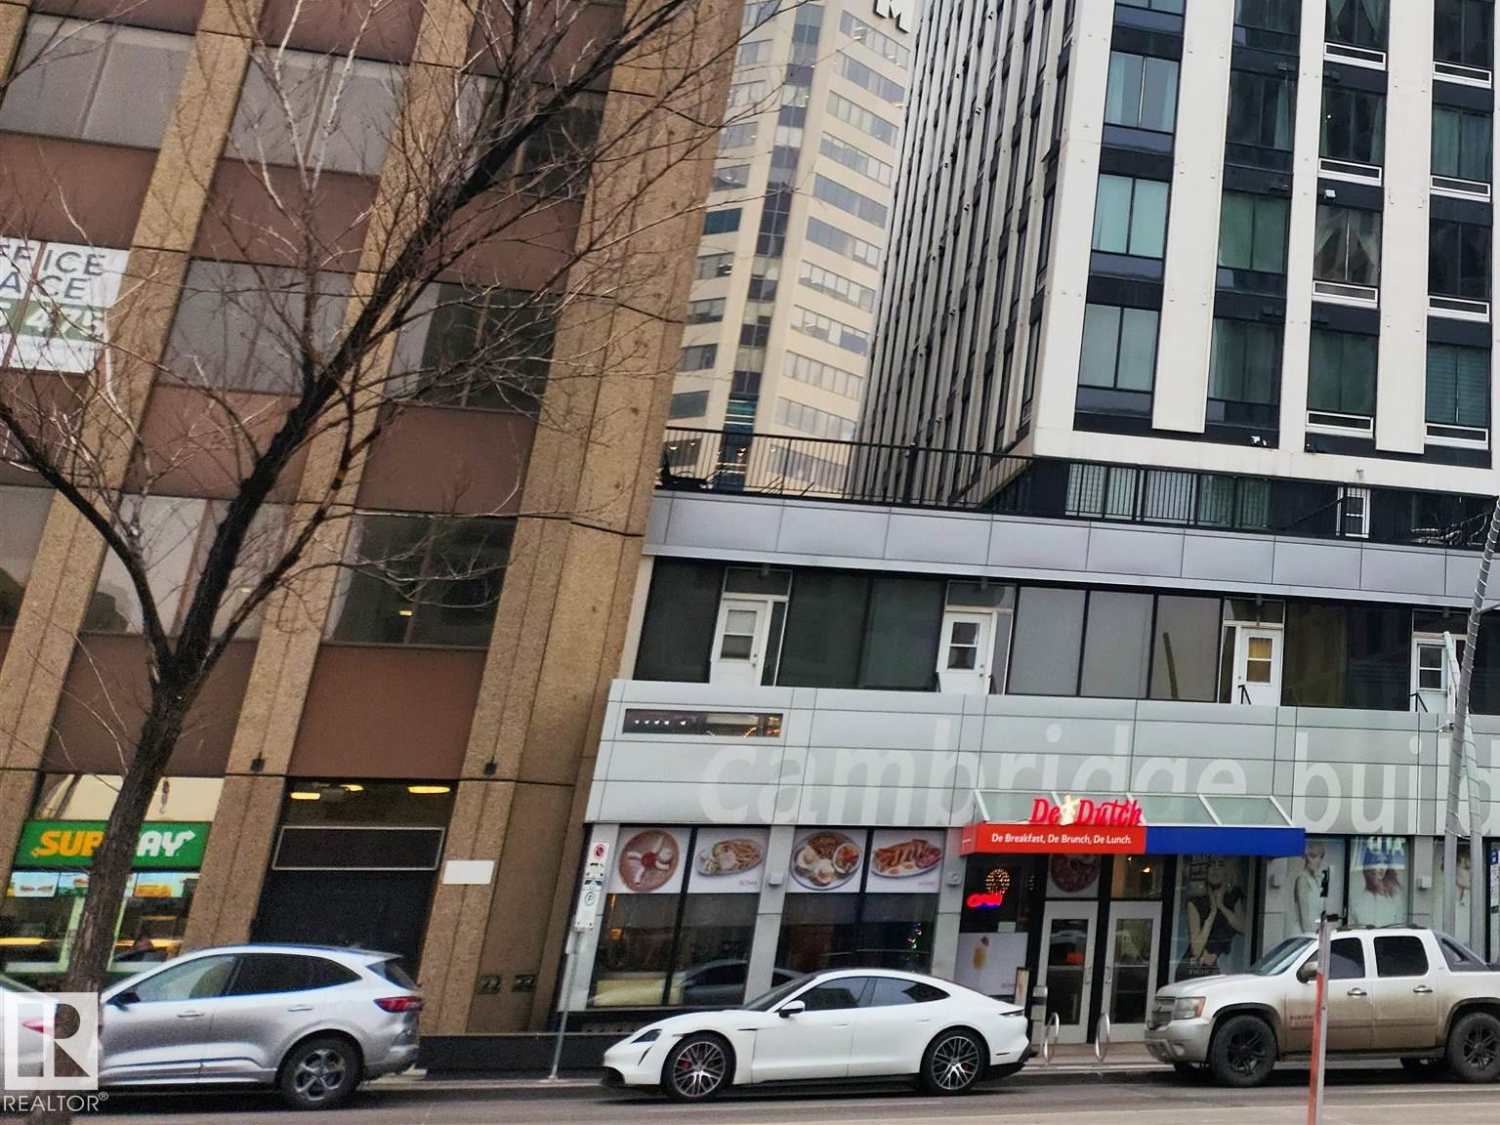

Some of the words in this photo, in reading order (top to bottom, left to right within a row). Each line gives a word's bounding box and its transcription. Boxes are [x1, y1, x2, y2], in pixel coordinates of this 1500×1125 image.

[1028, 798, 1060, 824] De
[1076, 799, 1142, 826] Dutch
[31, 829, 197, 858] SUBAY
[991, 833, 1003, 843] De
[1004, 833, 1046, 844] Breakfast,
[1047, 834, 1060, 844] De
[1061, 834, 1092, 845] Brunch,
[1093, 835, 1105, 844] De
